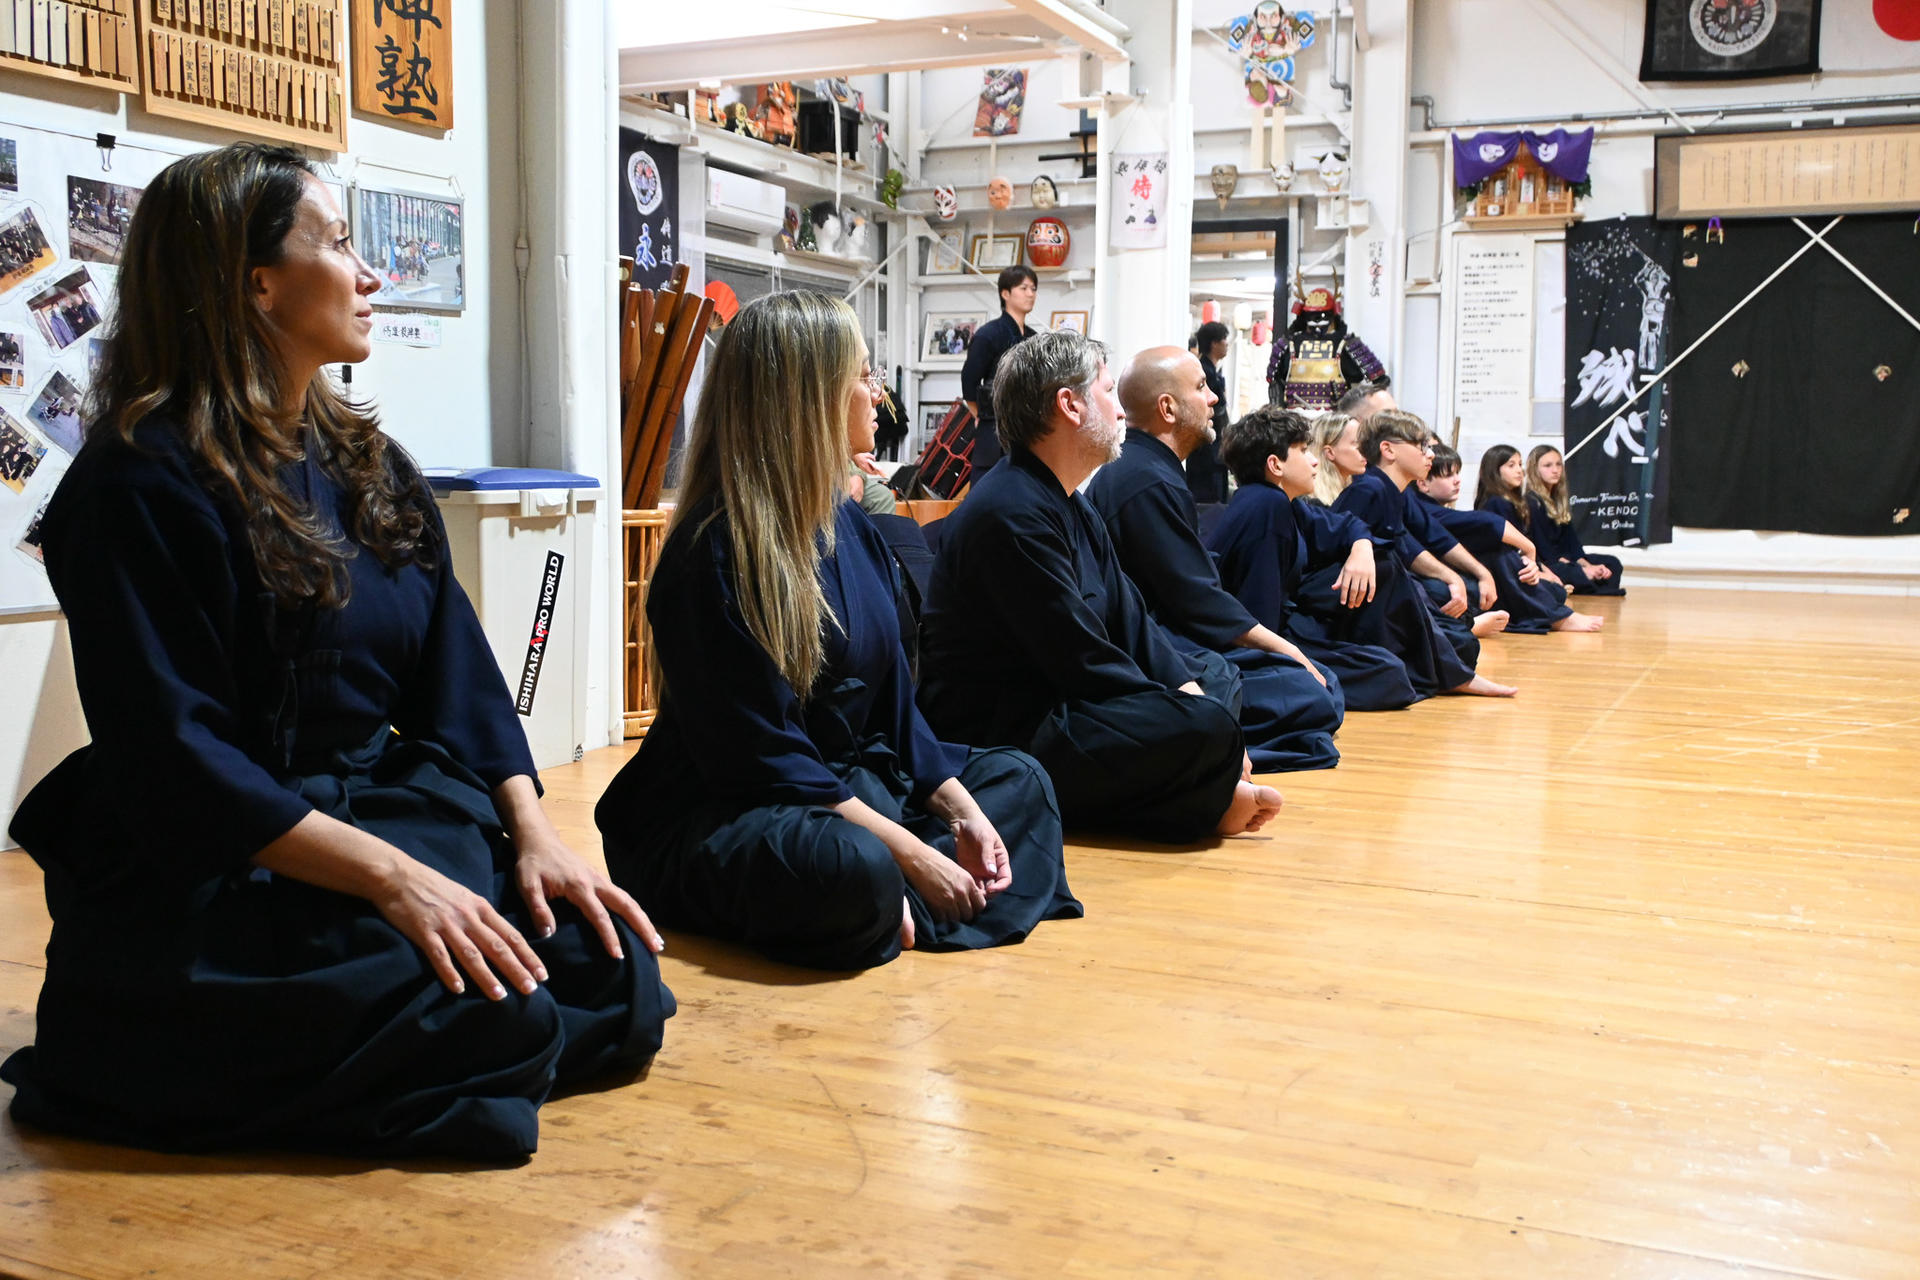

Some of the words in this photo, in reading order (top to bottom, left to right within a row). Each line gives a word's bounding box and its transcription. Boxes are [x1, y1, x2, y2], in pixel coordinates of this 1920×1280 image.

[1599, 492, 1627, 503] Training
[542, 556, 560, 607] WORLD
[535, 609, 550, 638] PRO
[518, 643, 543, 712] ISHIHARA
